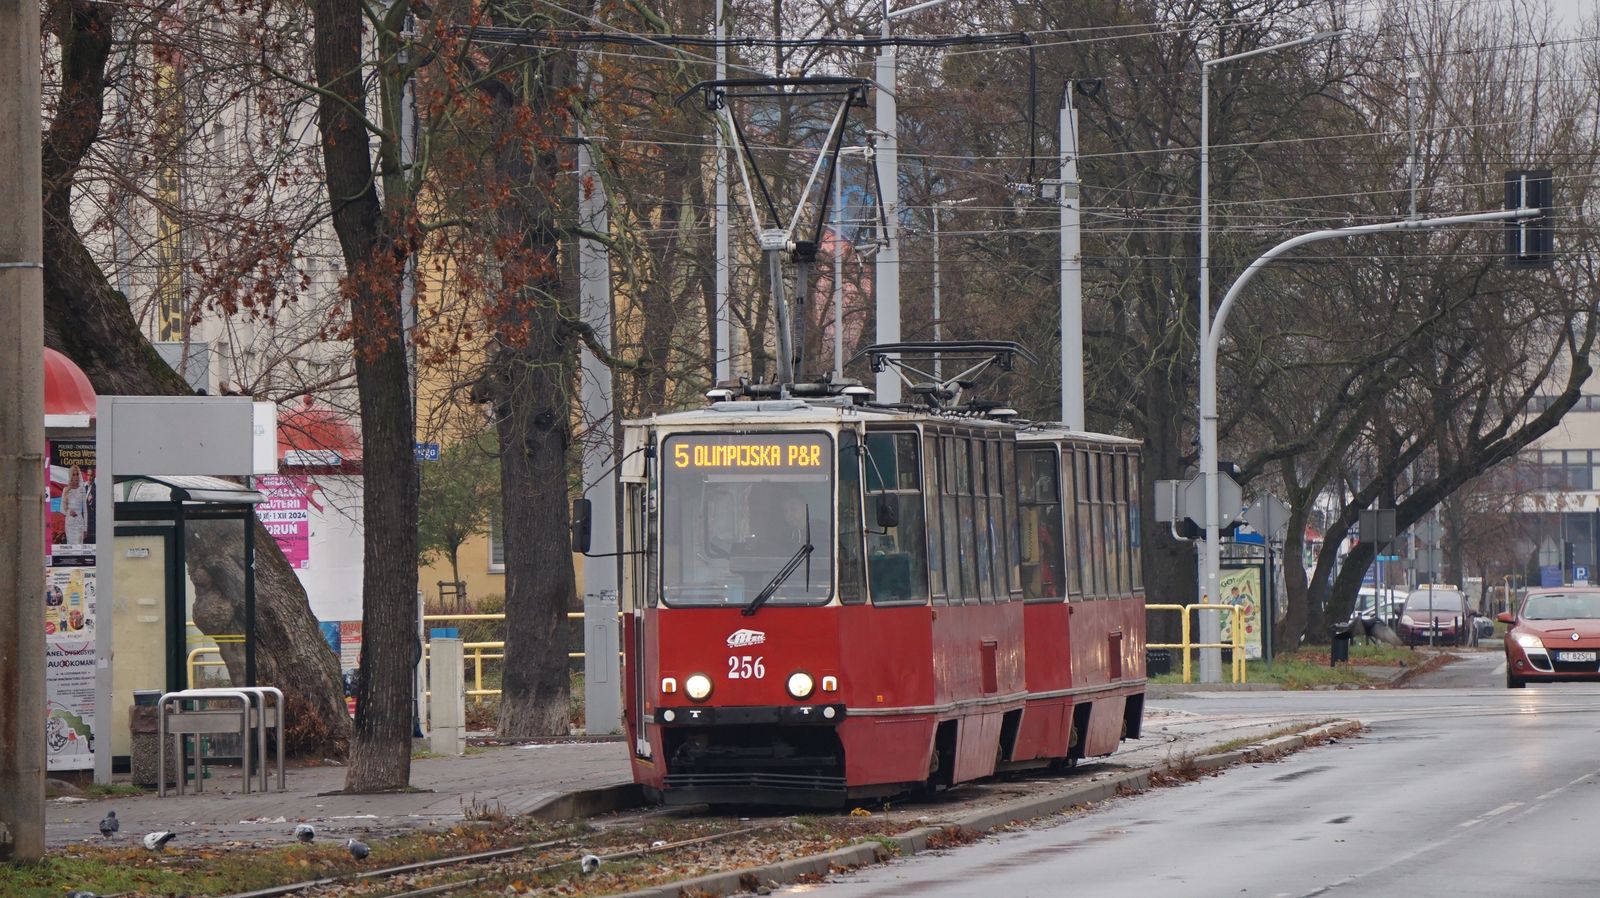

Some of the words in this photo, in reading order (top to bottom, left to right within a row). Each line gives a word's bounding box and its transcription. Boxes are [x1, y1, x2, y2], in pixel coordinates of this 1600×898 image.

[675, 444, 689, 468] 5
[694, 445, 781, 466] OLIMPIJSKA
[788, 445, 820, 466] P&R
[728, 655, 765, 679] 256
